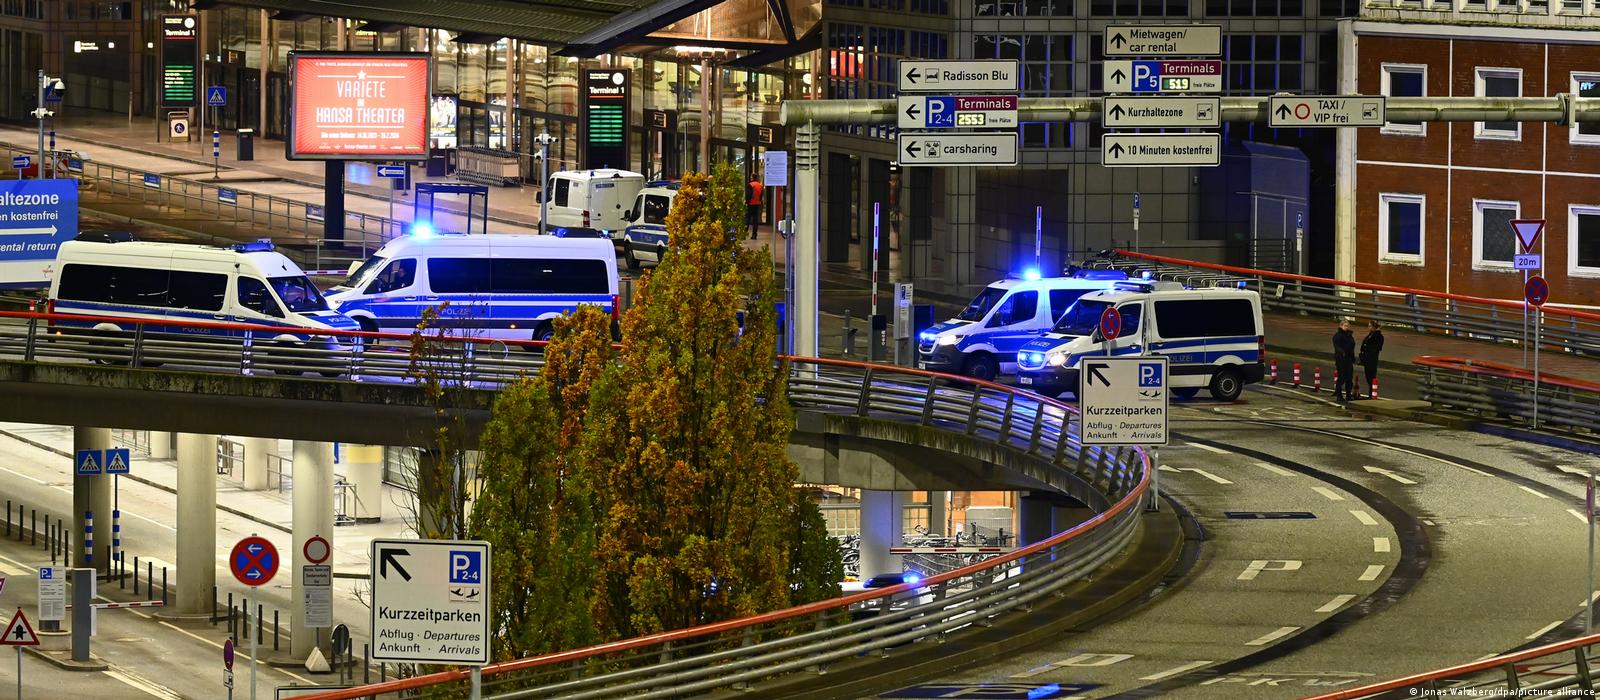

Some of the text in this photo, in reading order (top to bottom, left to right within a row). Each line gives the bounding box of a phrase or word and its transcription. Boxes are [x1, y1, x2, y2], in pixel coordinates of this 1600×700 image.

[1130, 29, 1187, 40] Mietwagen/
[1129, 43, 1177, 52] car rental
[1163, 63, 1215, 73] Terminals
[943, 71, 1008, 80] Radisson Blu
[1169, 79, 1189, 89] 519
[589, 86, 625, 94] Terminal 1
[958, 99, 1011, 109] Terminals
[1318, 100, 1339, 110] TAXI
[316, 107, 405, 123] HANSA THEATER
[1128, 107, 1183, 117] Kurzhaltezone
[958, 114, 984, 125] 2553
[1314, 113, 1349, 123] VIP frei
[944, 144, 997, 156] carsharing
[1128, 145, 1213, 155] 10 Minuten kostenfrei
[10, 211, 58, 221] kostenfrei
[27, 243, 57, 251] return
[1086, 405, 1162, 417] Kurzzeitparken
[1087, 421, 1162, 430] Abflug Departures
[1087, 431, 1162, 439] Ankunft Arrivals
[1236, 560, 1303, 580] P
[379, 606, 481, 624] Kurzzeitparken
[379, 629, 480, 642] Abflug Departures
[379, 642, 480, 655] Ankunft Arrivals
